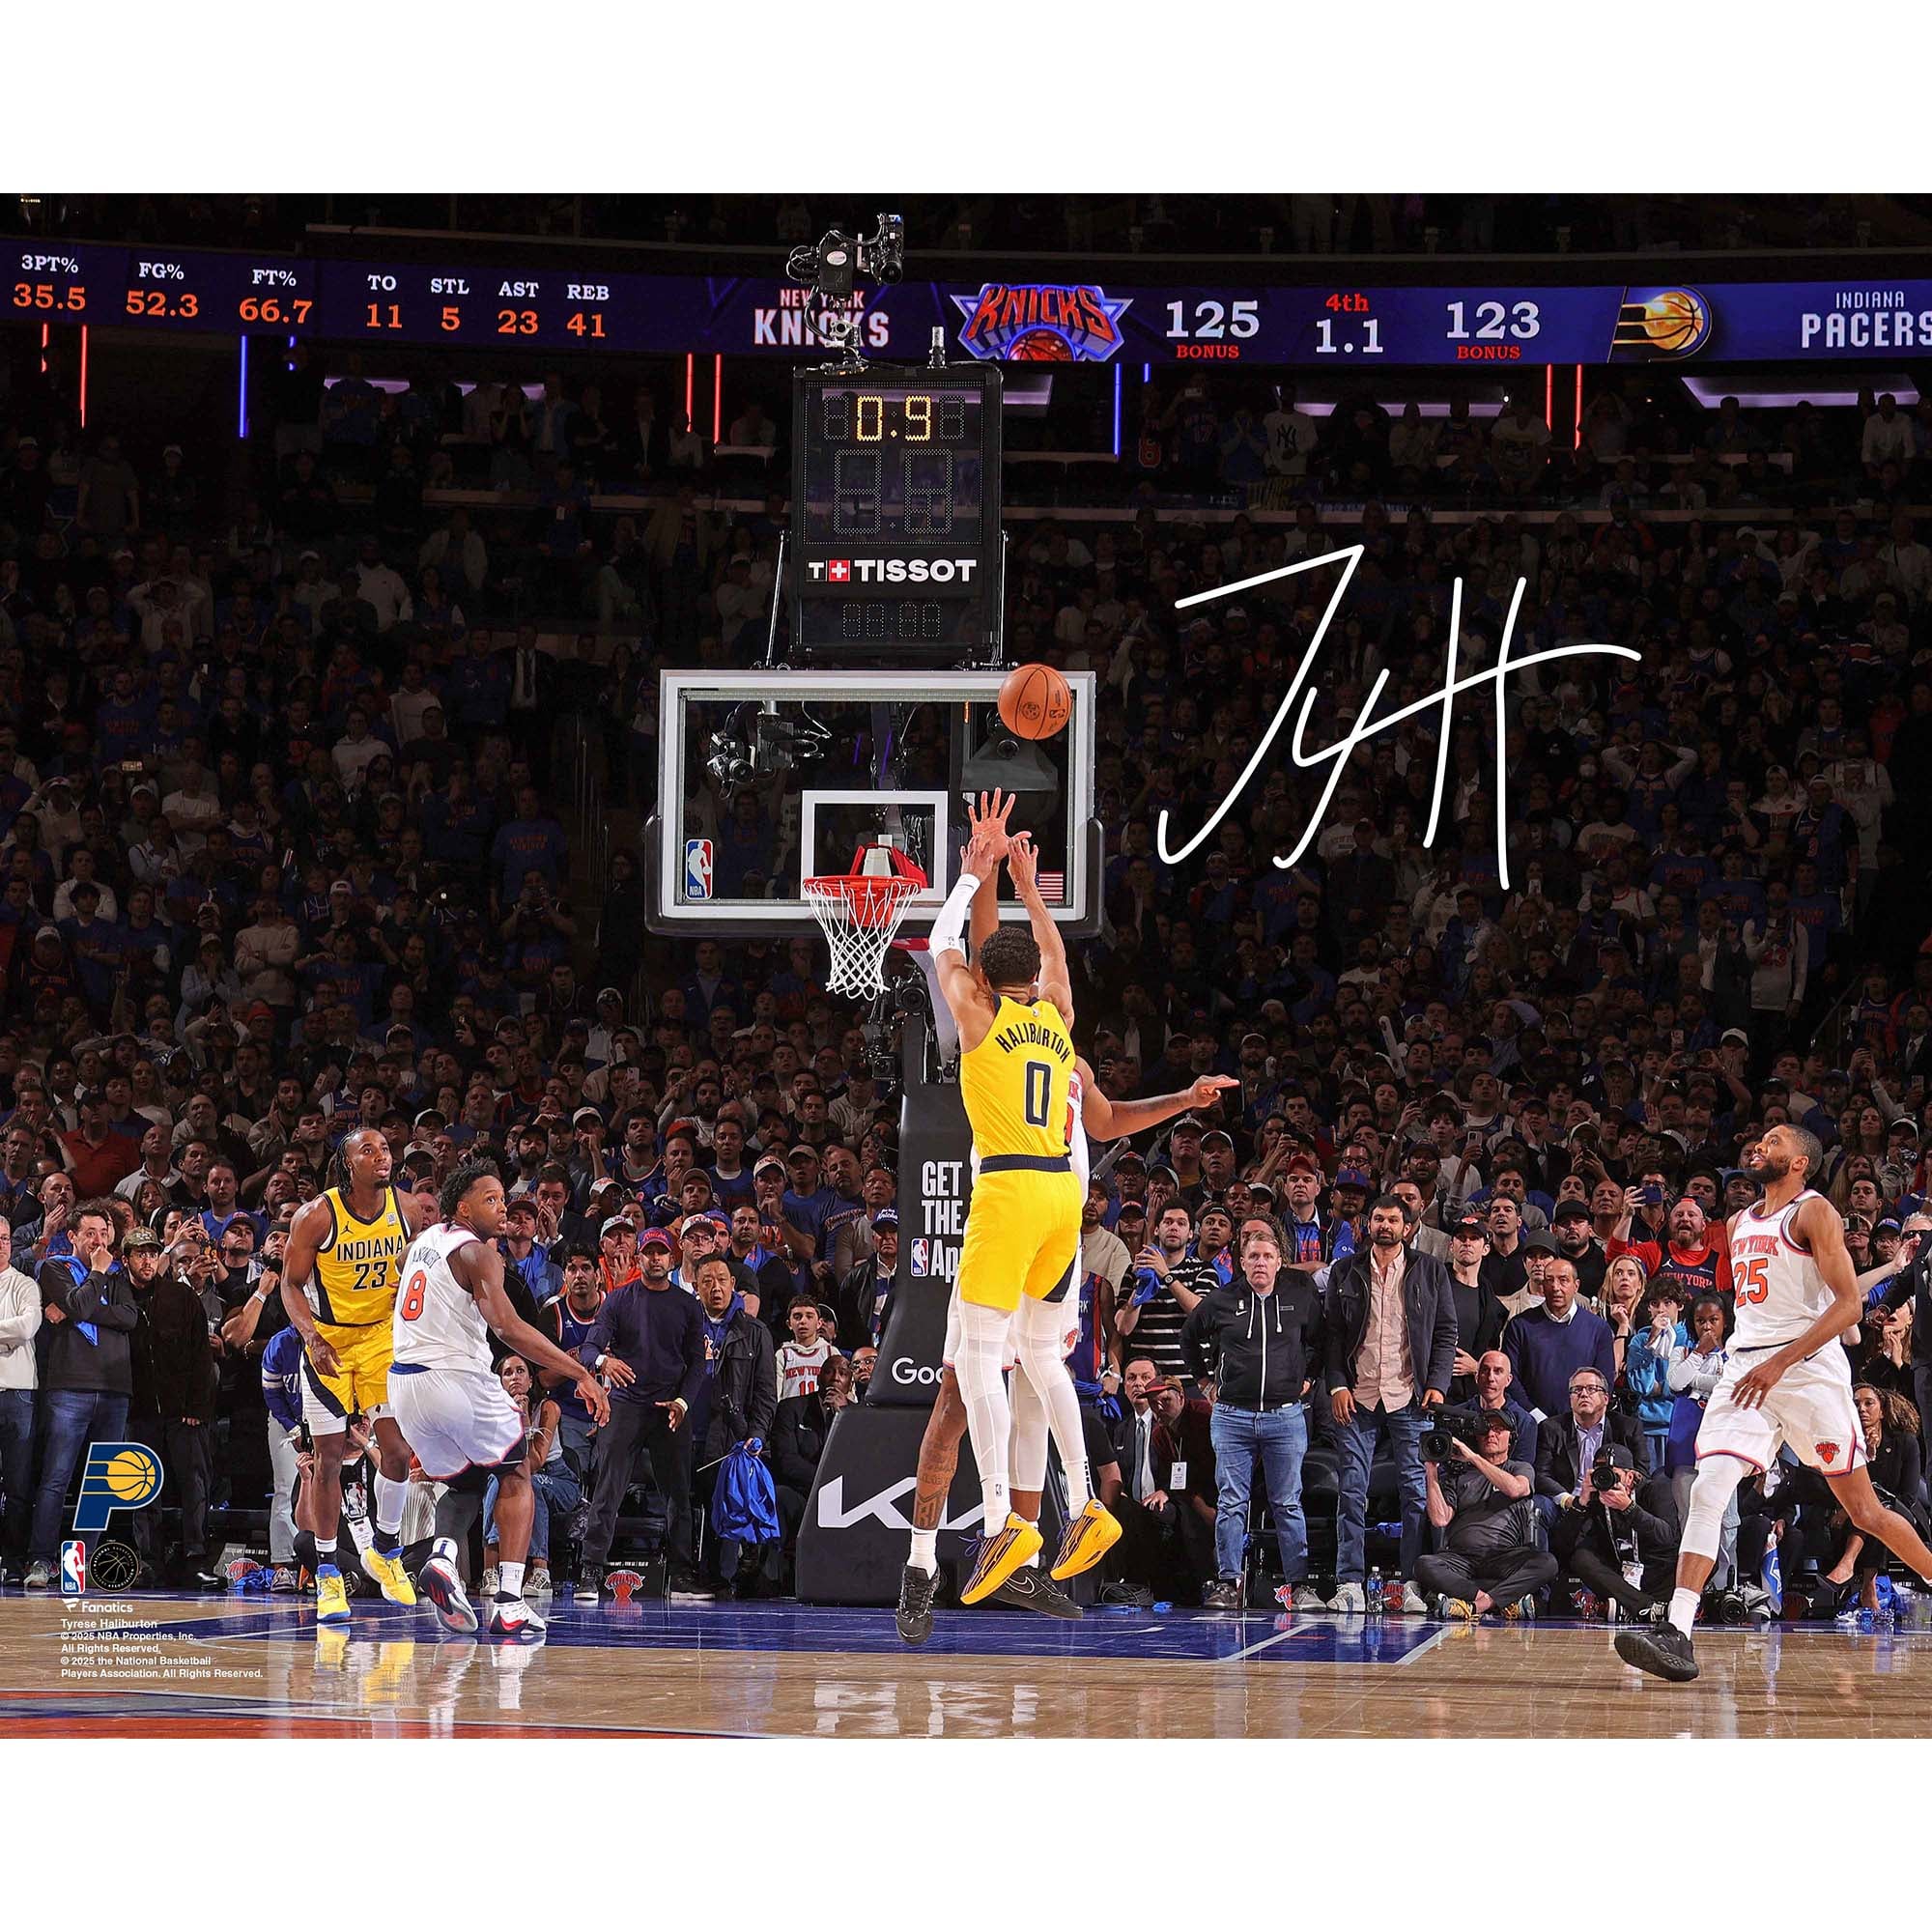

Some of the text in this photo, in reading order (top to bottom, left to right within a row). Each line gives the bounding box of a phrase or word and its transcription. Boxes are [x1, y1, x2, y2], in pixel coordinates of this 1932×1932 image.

[21, 254, 79, 274] 3PT%
[138, 262, 185, 281] FG%
[251, 269, 297, 288] FT%
[367, 274, 397, 292] TO
[430, 277, 469, 295] STL
[497, 281, 540, 298] AST
[13, 283, 86, 311] 35.5
[126, 291, 199, 318] 52.3
[566, 284, 610, 301] REB
[1325, 293, 1369, 312] 4th
[1835, 290, 1905, 309] INDIANA
[239, 298, 313, 324] 66.7
[366, 303, 403, 328] 11
[440, 307, 461, 331] 5
[497, 310, 539, 334] 23
[966, 285, 1116, 343] KNICKS
[1166, 299, 1260, 339] 125
[1446, 300, 1541, 340] 123
[566, 313, 606, 337] 41
[1316, 318, 1384, 354] 1.1
[1801, 310, 1932, 349] PACERS
[1176, 344, 1240, 359] BONUS
[1457, 345, 1521, 360] BONUS
[856, 393, 933, 442] 0.9
[854, 558, 978, 582] TISSOT
[689, 886, 703, 896] NBA
[995, 1022, 1071, 1064] HALIBURTON
[1026, 1061, 1051, 1127] 0
[922, 1160, 963, 1197] GET
[921, 1200, 964, 1235] THE
[336, 1236, 403, 1262] INDIANA
[1747, 1235, 1779, 1257] YORK
[352, 1260, 388, 1291] 23
[1733, 1257, 1769, 1309] 25
[401, 1269, 427, 1321] 8
[798, 1380, 815, 1397] 11
